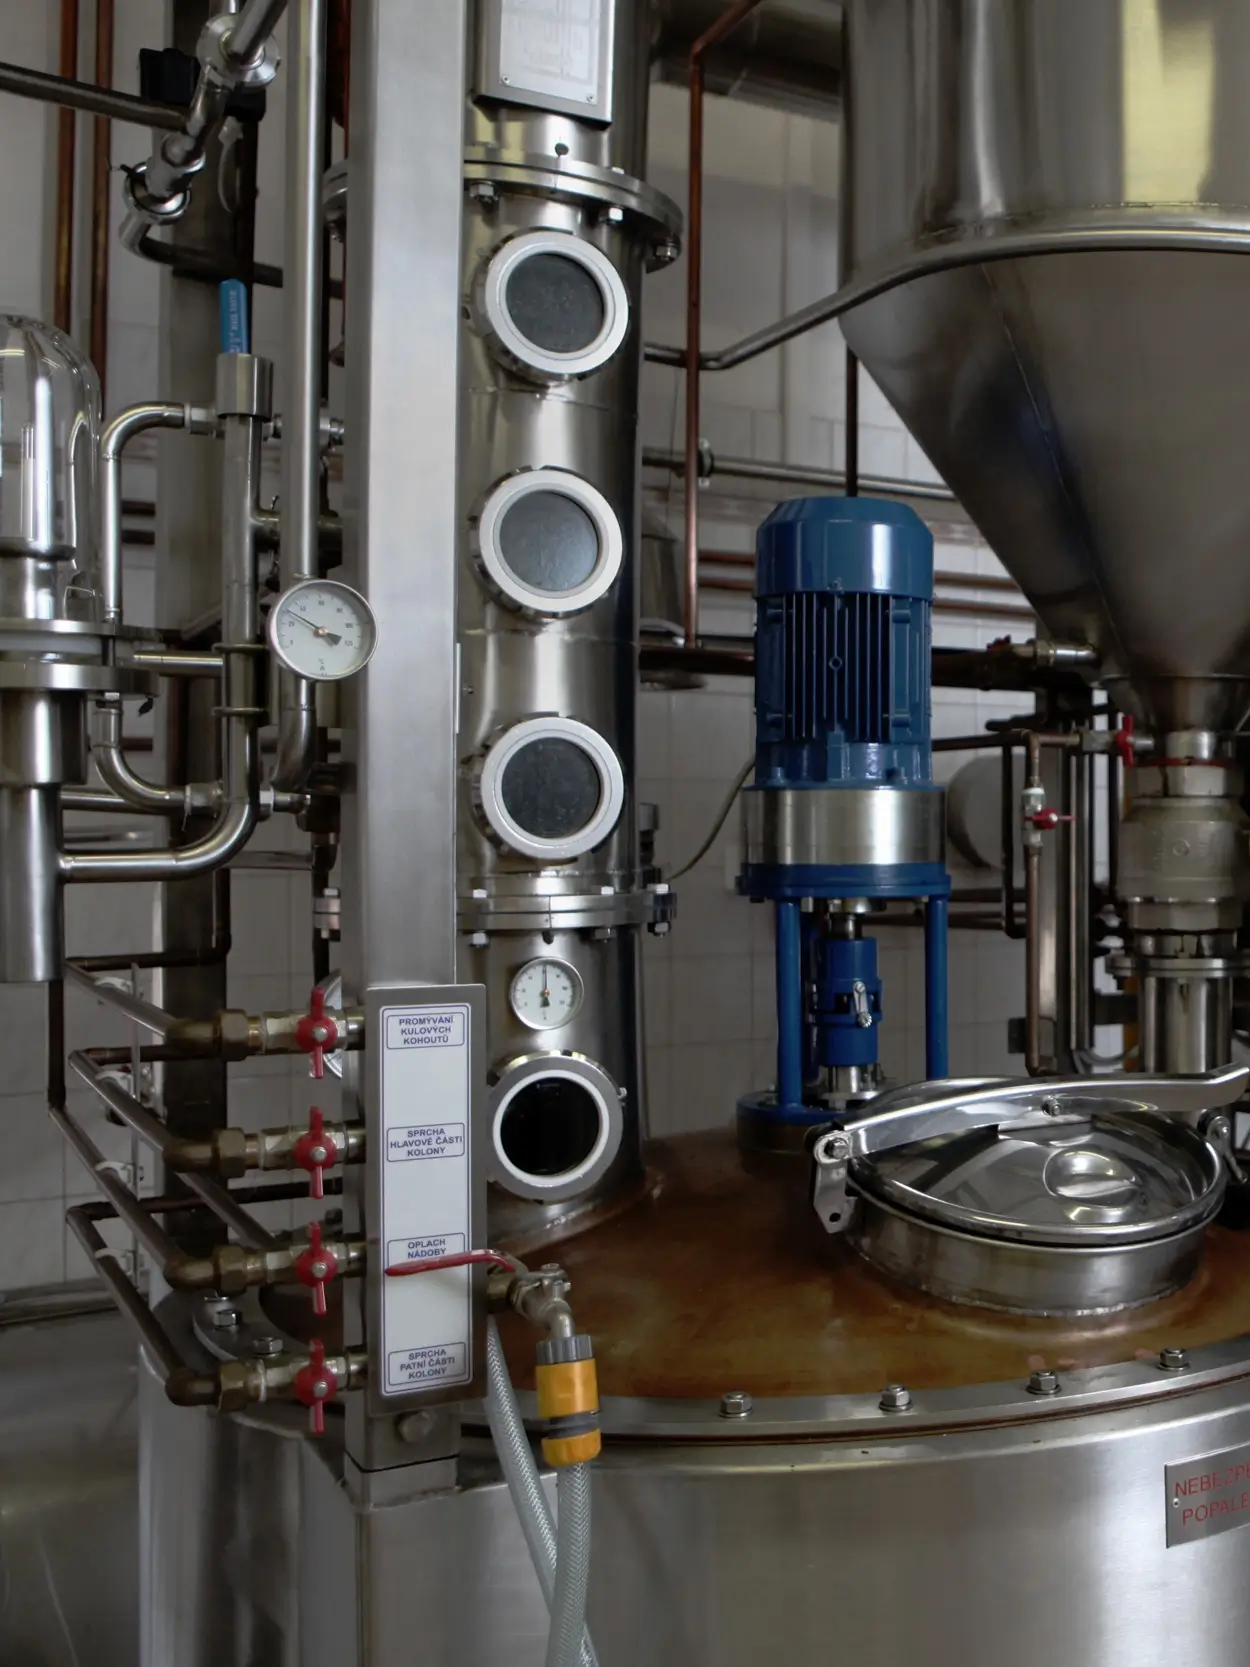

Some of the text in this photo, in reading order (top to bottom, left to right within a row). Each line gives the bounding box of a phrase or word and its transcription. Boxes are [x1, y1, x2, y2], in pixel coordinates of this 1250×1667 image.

[401, 1026, 451, 1035] KULOVÝCH
[403, 1034, 449, 1045] KOHOUTŮ
[407, 1128, 446, 1138] SPRCHA
[390, 1135, 463, 1149] HLAVOVÉ ČÁSTI
[407, 1147, 446, 1157] KOLONY
[407, 1238, 446, 1249] OPLACH
[407, 1248, 446, 1259] NÁDOBY
[408, 1349, 447, 1361] SPRCHA
[400, 1356, 455, 1371] PATNÍ ČÁSTI
[408, 1367, 448, 1379] KOLONY
